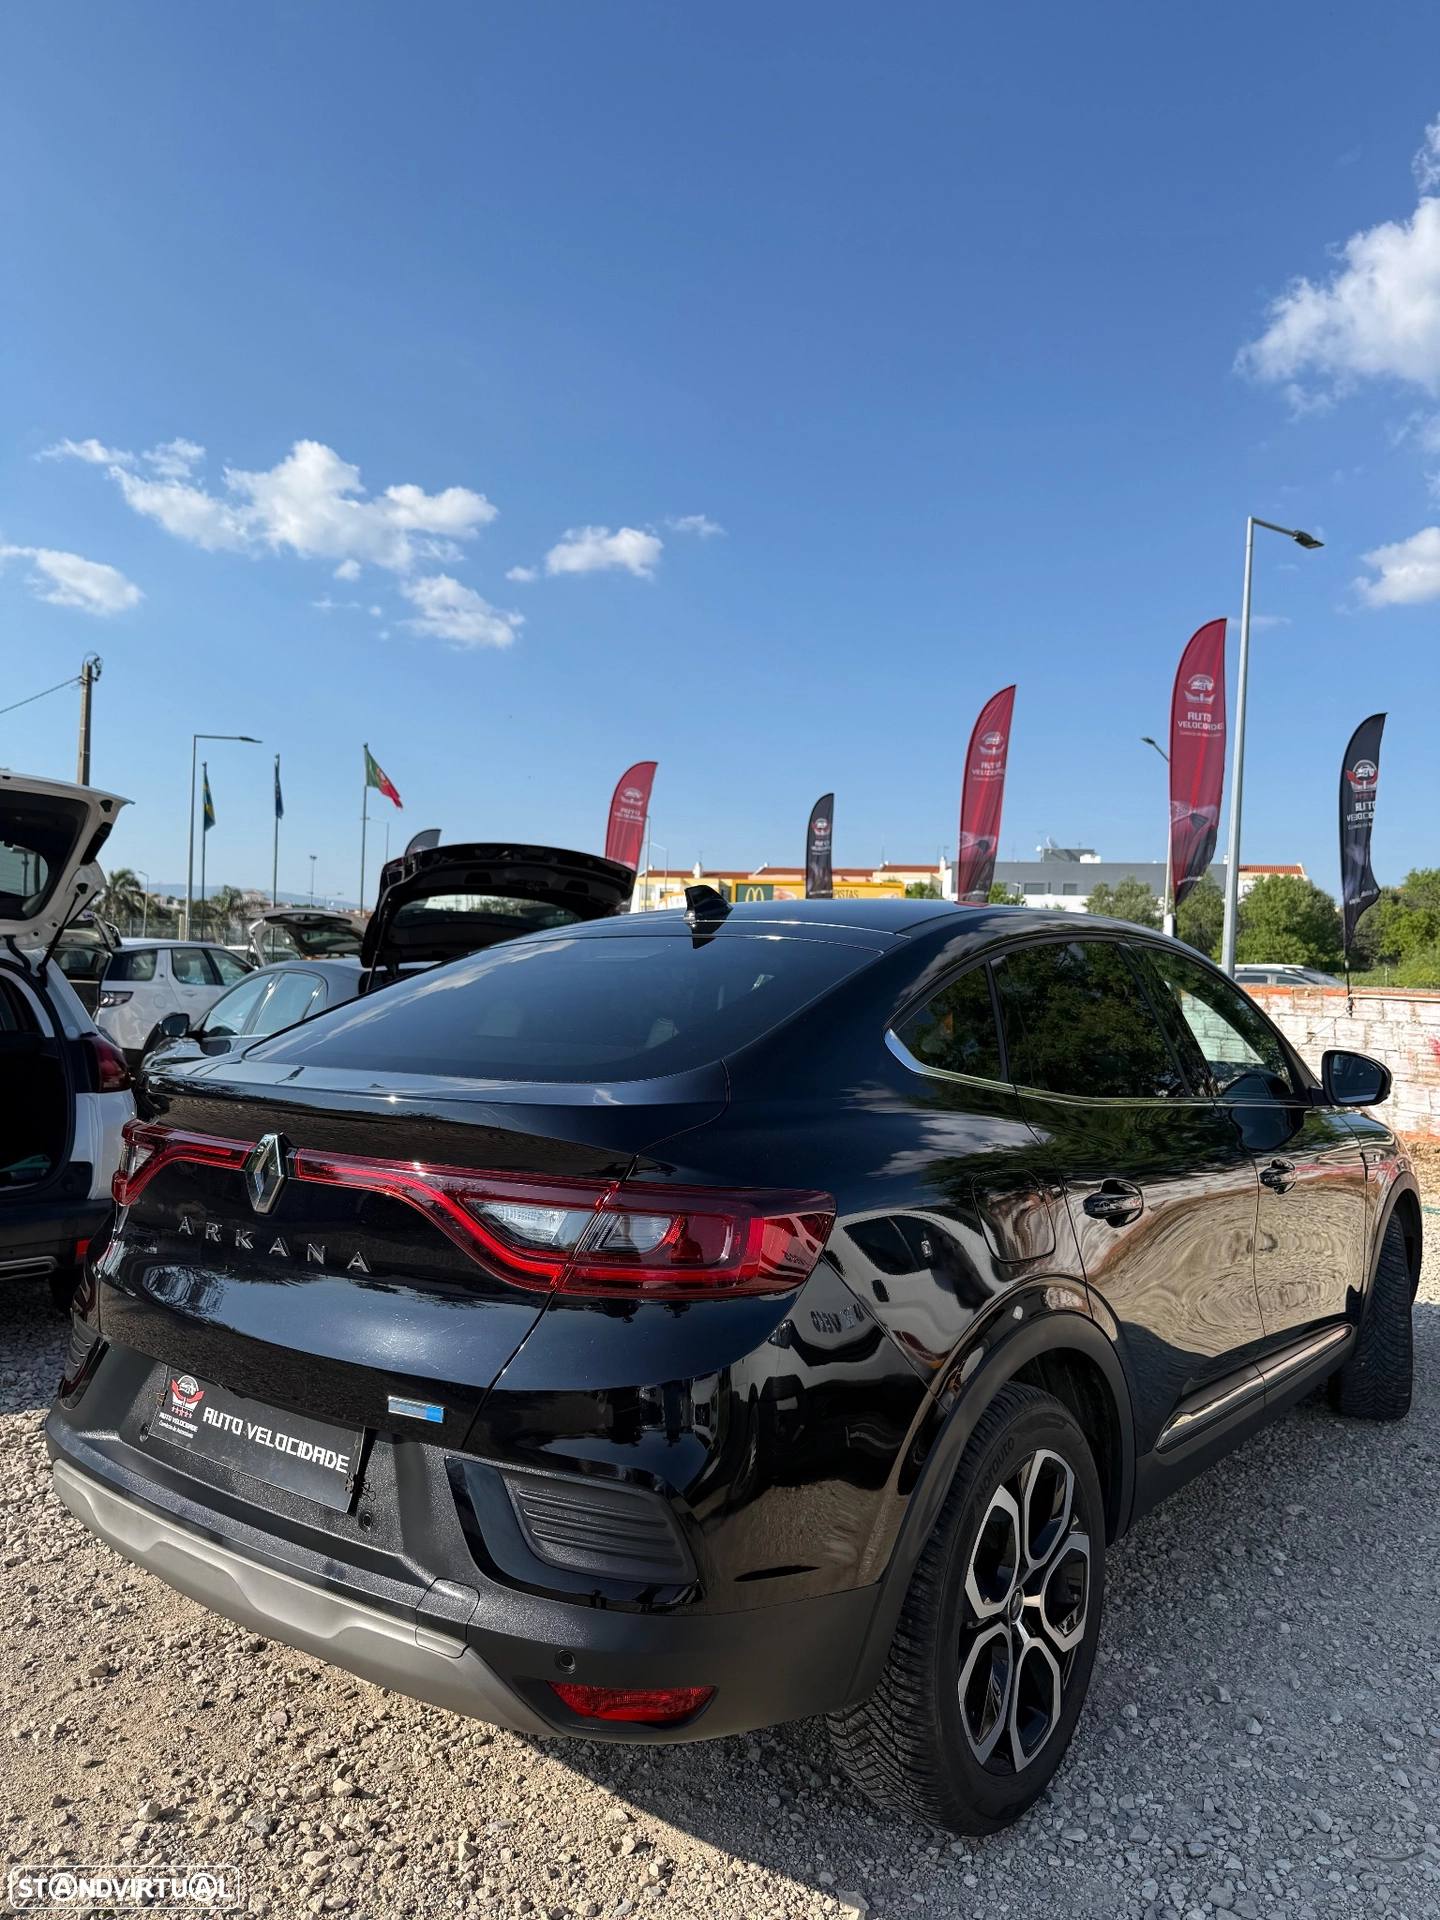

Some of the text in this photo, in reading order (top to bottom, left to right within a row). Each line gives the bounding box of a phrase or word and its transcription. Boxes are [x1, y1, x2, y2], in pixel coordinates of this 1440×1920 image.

[1187, 711, 1212, 722] AUTO
[178, 1216, 371, 1273] ARKANA
[203, 1407, 350, 1473] AUTO VELOCIDADE
